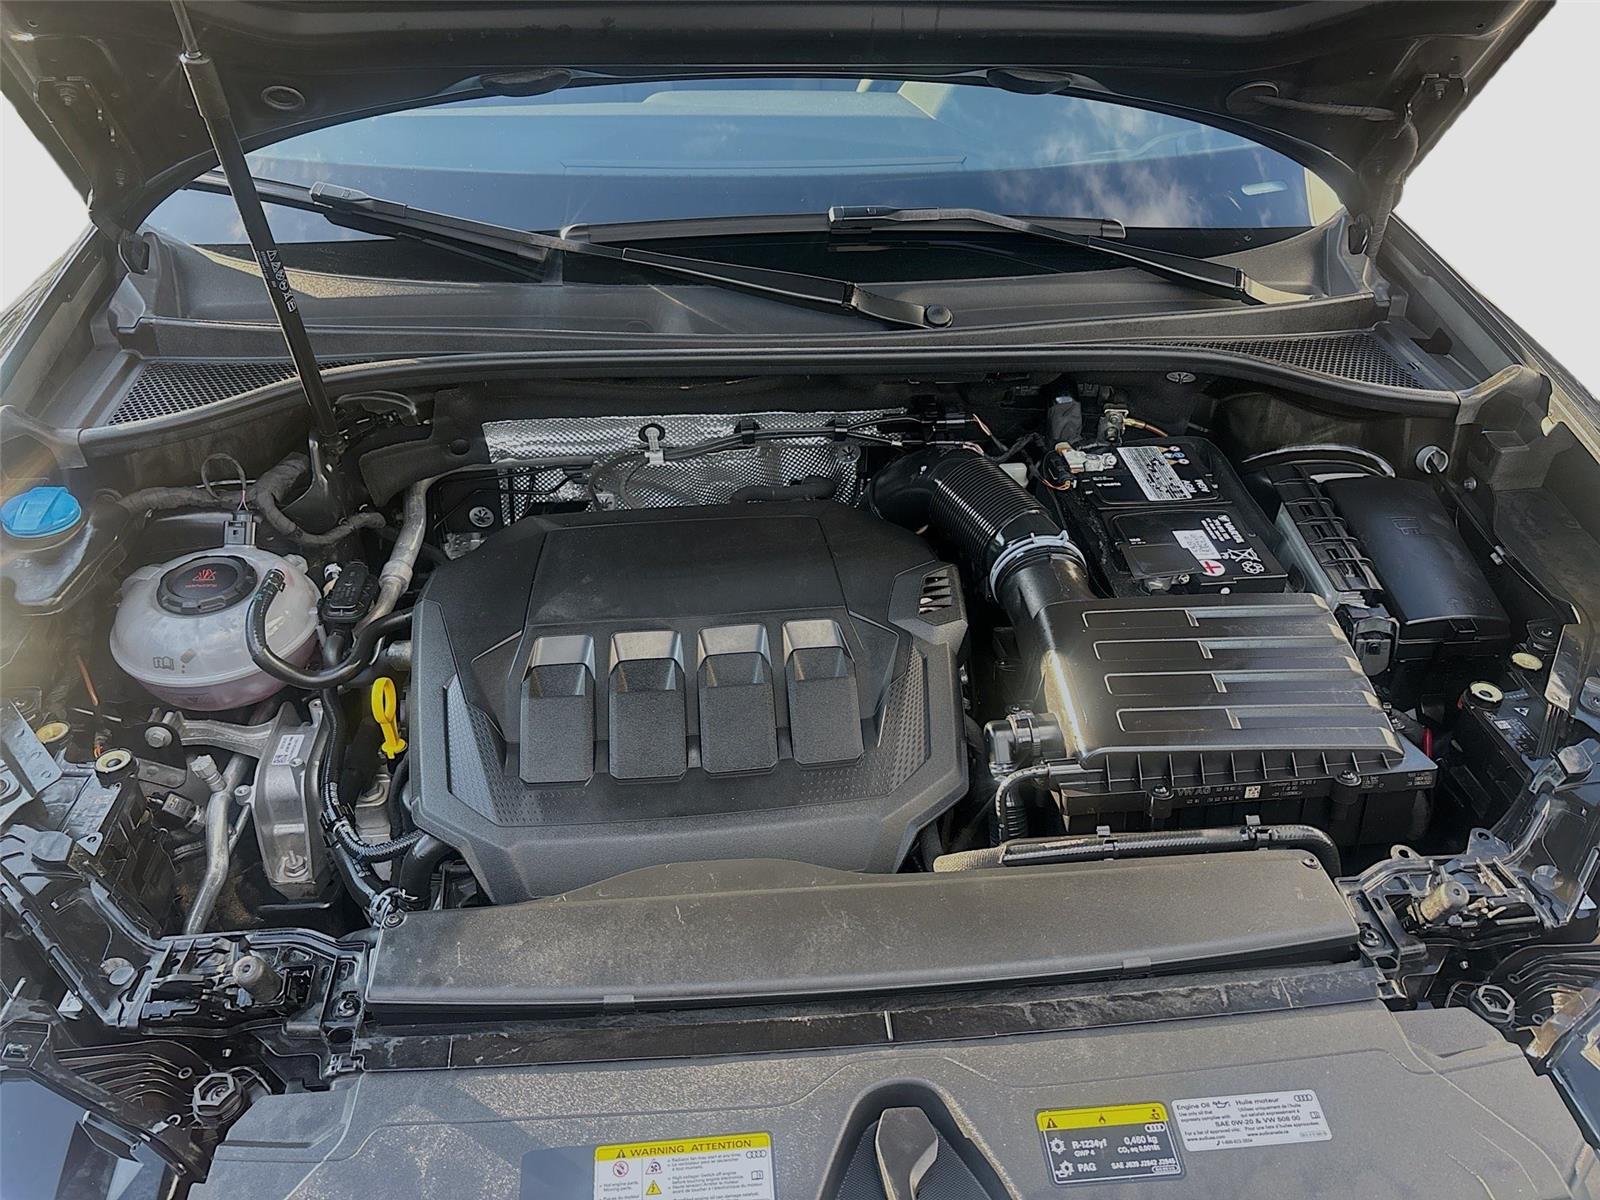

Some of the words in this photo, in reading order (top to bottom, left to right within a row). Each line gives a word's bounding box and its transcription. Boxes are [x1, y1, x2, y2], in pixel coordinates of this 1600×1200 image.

[1146, 1134, 1158, 1144] kg
[630, 1145, 685, 1158] WARNING
[691, 1139, 752, 1152] ATTENTION
[1077, 1162, 1097, 1172] PAG
